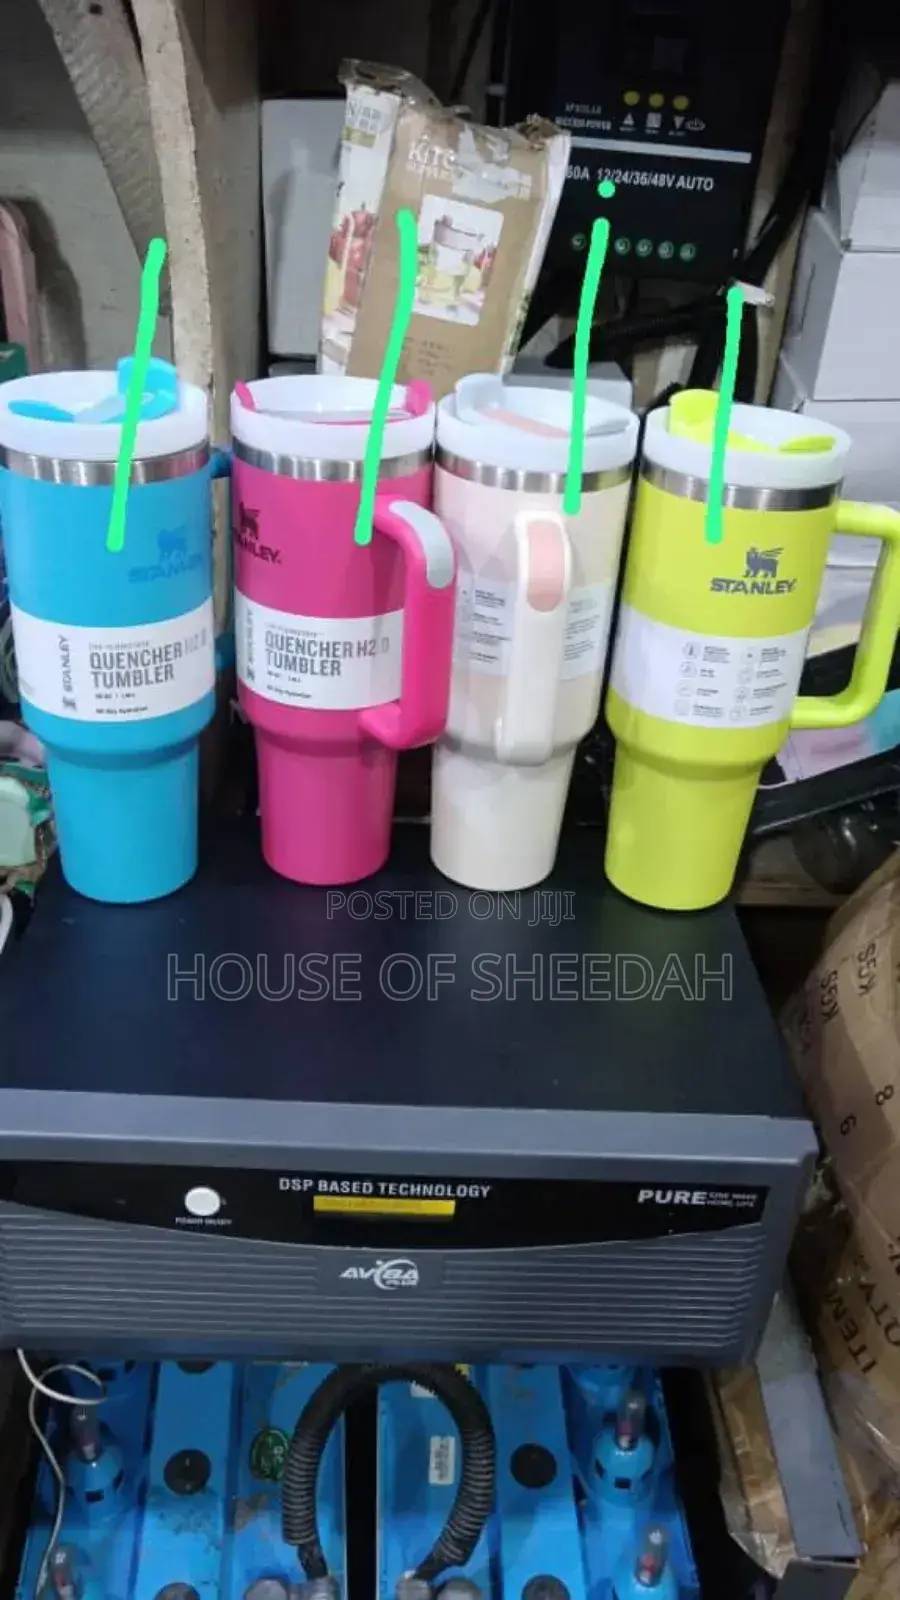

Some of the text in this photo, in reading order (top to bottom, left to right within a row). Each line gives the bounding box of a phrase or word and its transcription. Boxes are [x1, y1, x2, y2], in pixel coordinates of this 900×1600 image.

[676, 176, 714, 191] AUTO
[710, 577, 797, 595] STANLEY
[90, 641, 182, 670] QUENCHER
[264, 630, 357, 659] QUENCHER
[59, 634, 73, 692] STANLEY
[265, 648, 342, 677] TUMBLER
[90, 663, 175, 689] TUMBLER
[279, 1177, 491, 1198] DSP BASED TECHNOLOGY
[637, 1189, 706, 1205] PURE
